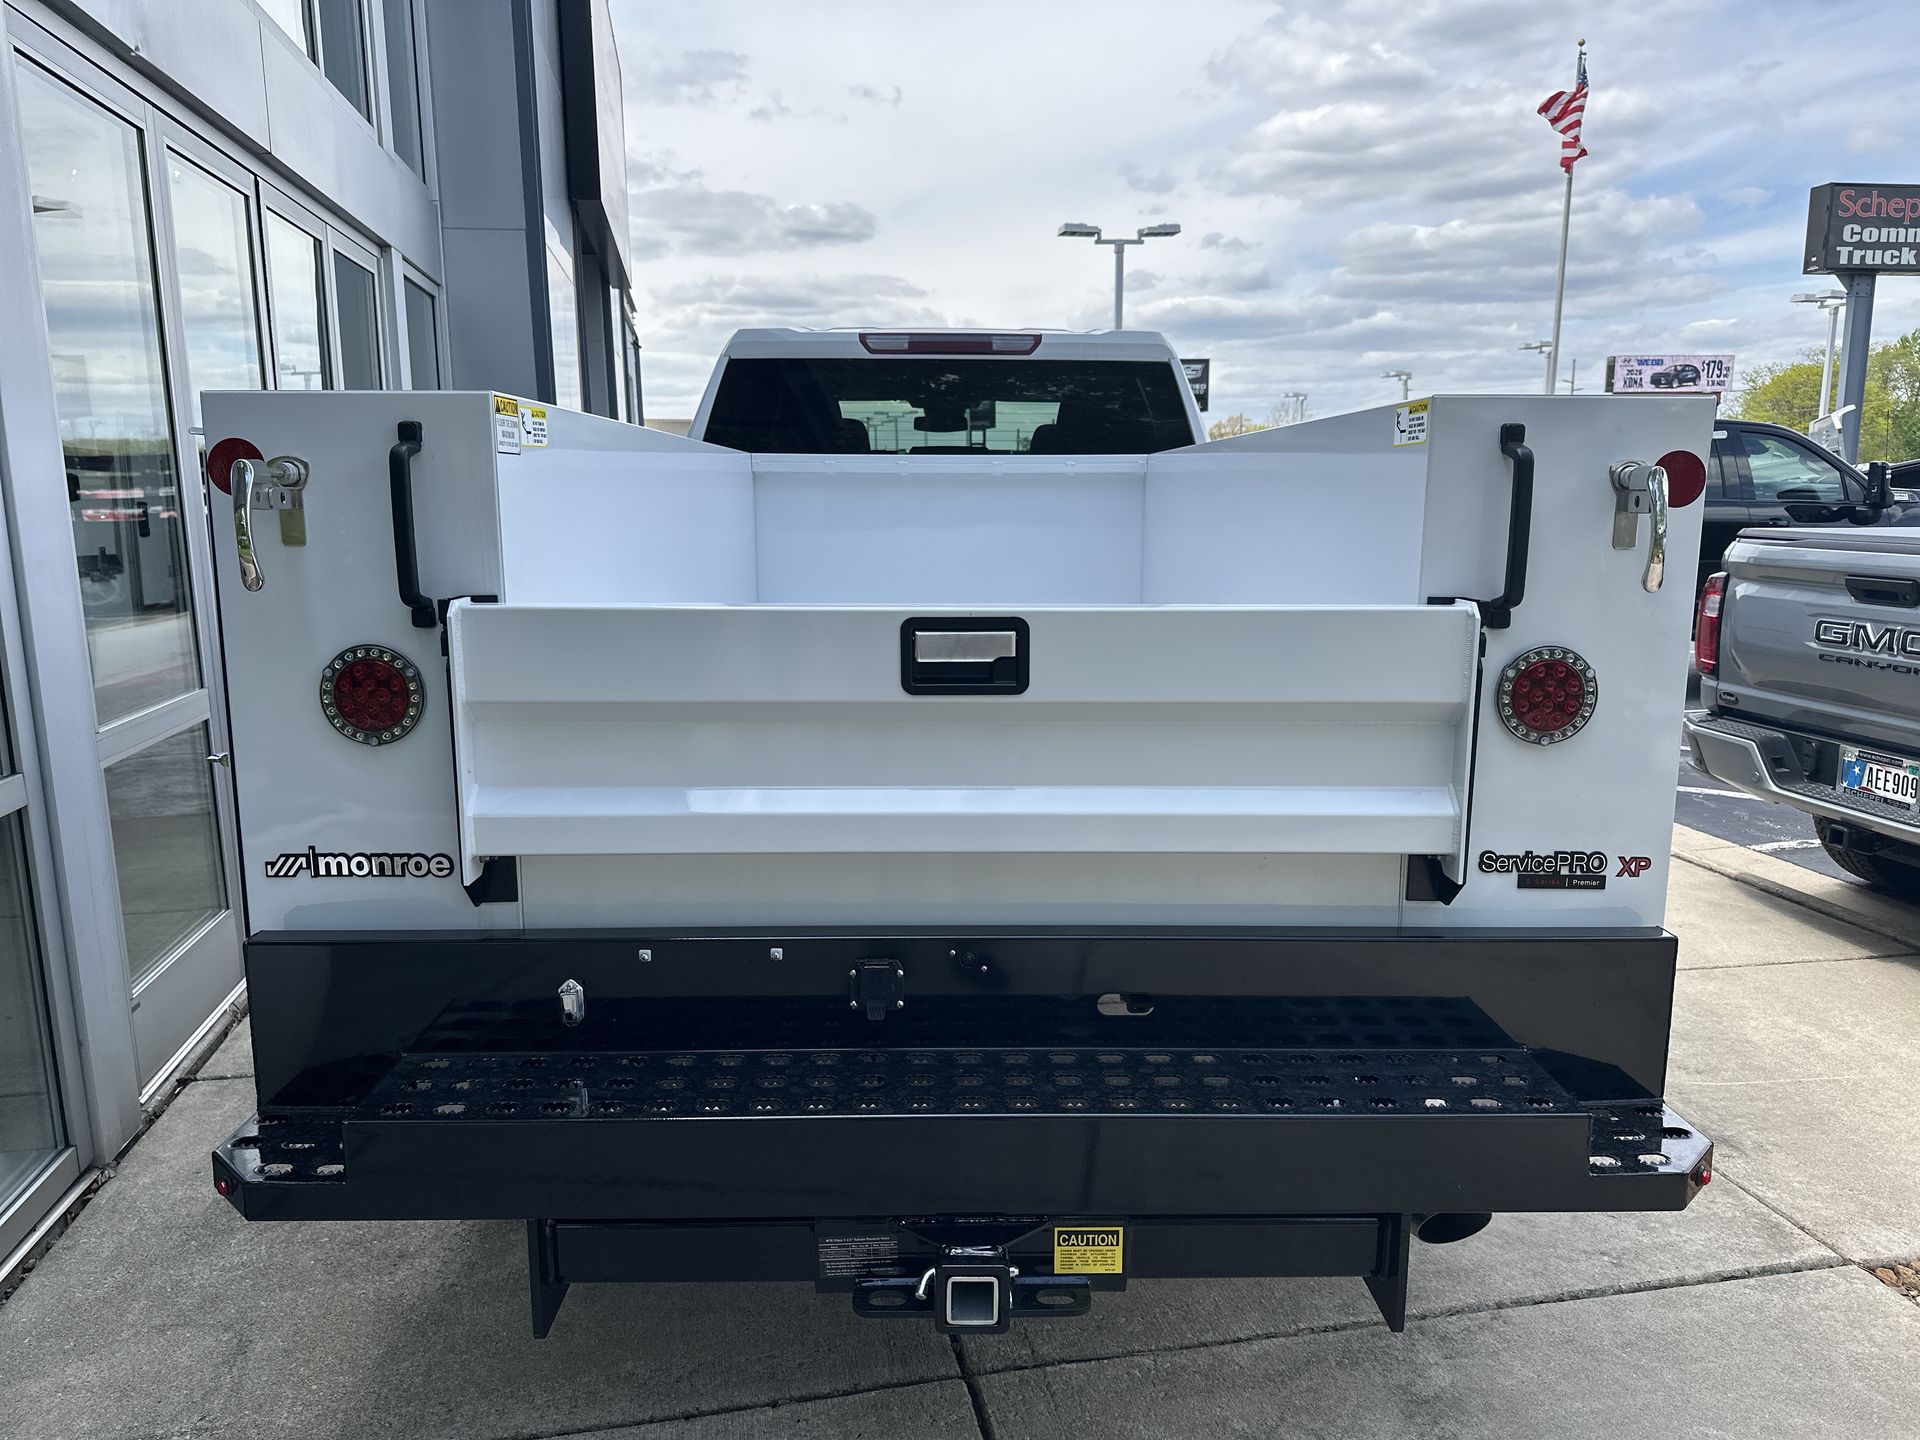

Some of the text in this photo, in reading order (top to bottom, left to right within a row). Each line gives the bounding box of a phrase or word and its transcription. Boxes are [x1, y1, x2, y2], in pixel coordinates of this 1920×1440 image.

[1837, 246, 1917, 265] Truck
[1702, 360, 1723, 379] $179
[1866, 766, 1919, 799] AEE909
[316, 852, 455, 878] monroe
[1479, 850, 1652, 878] ServicePRO XP
[1572, 878, 1601, 887] Premier
[1059, 1234, 1117, 1246] CAUTION
